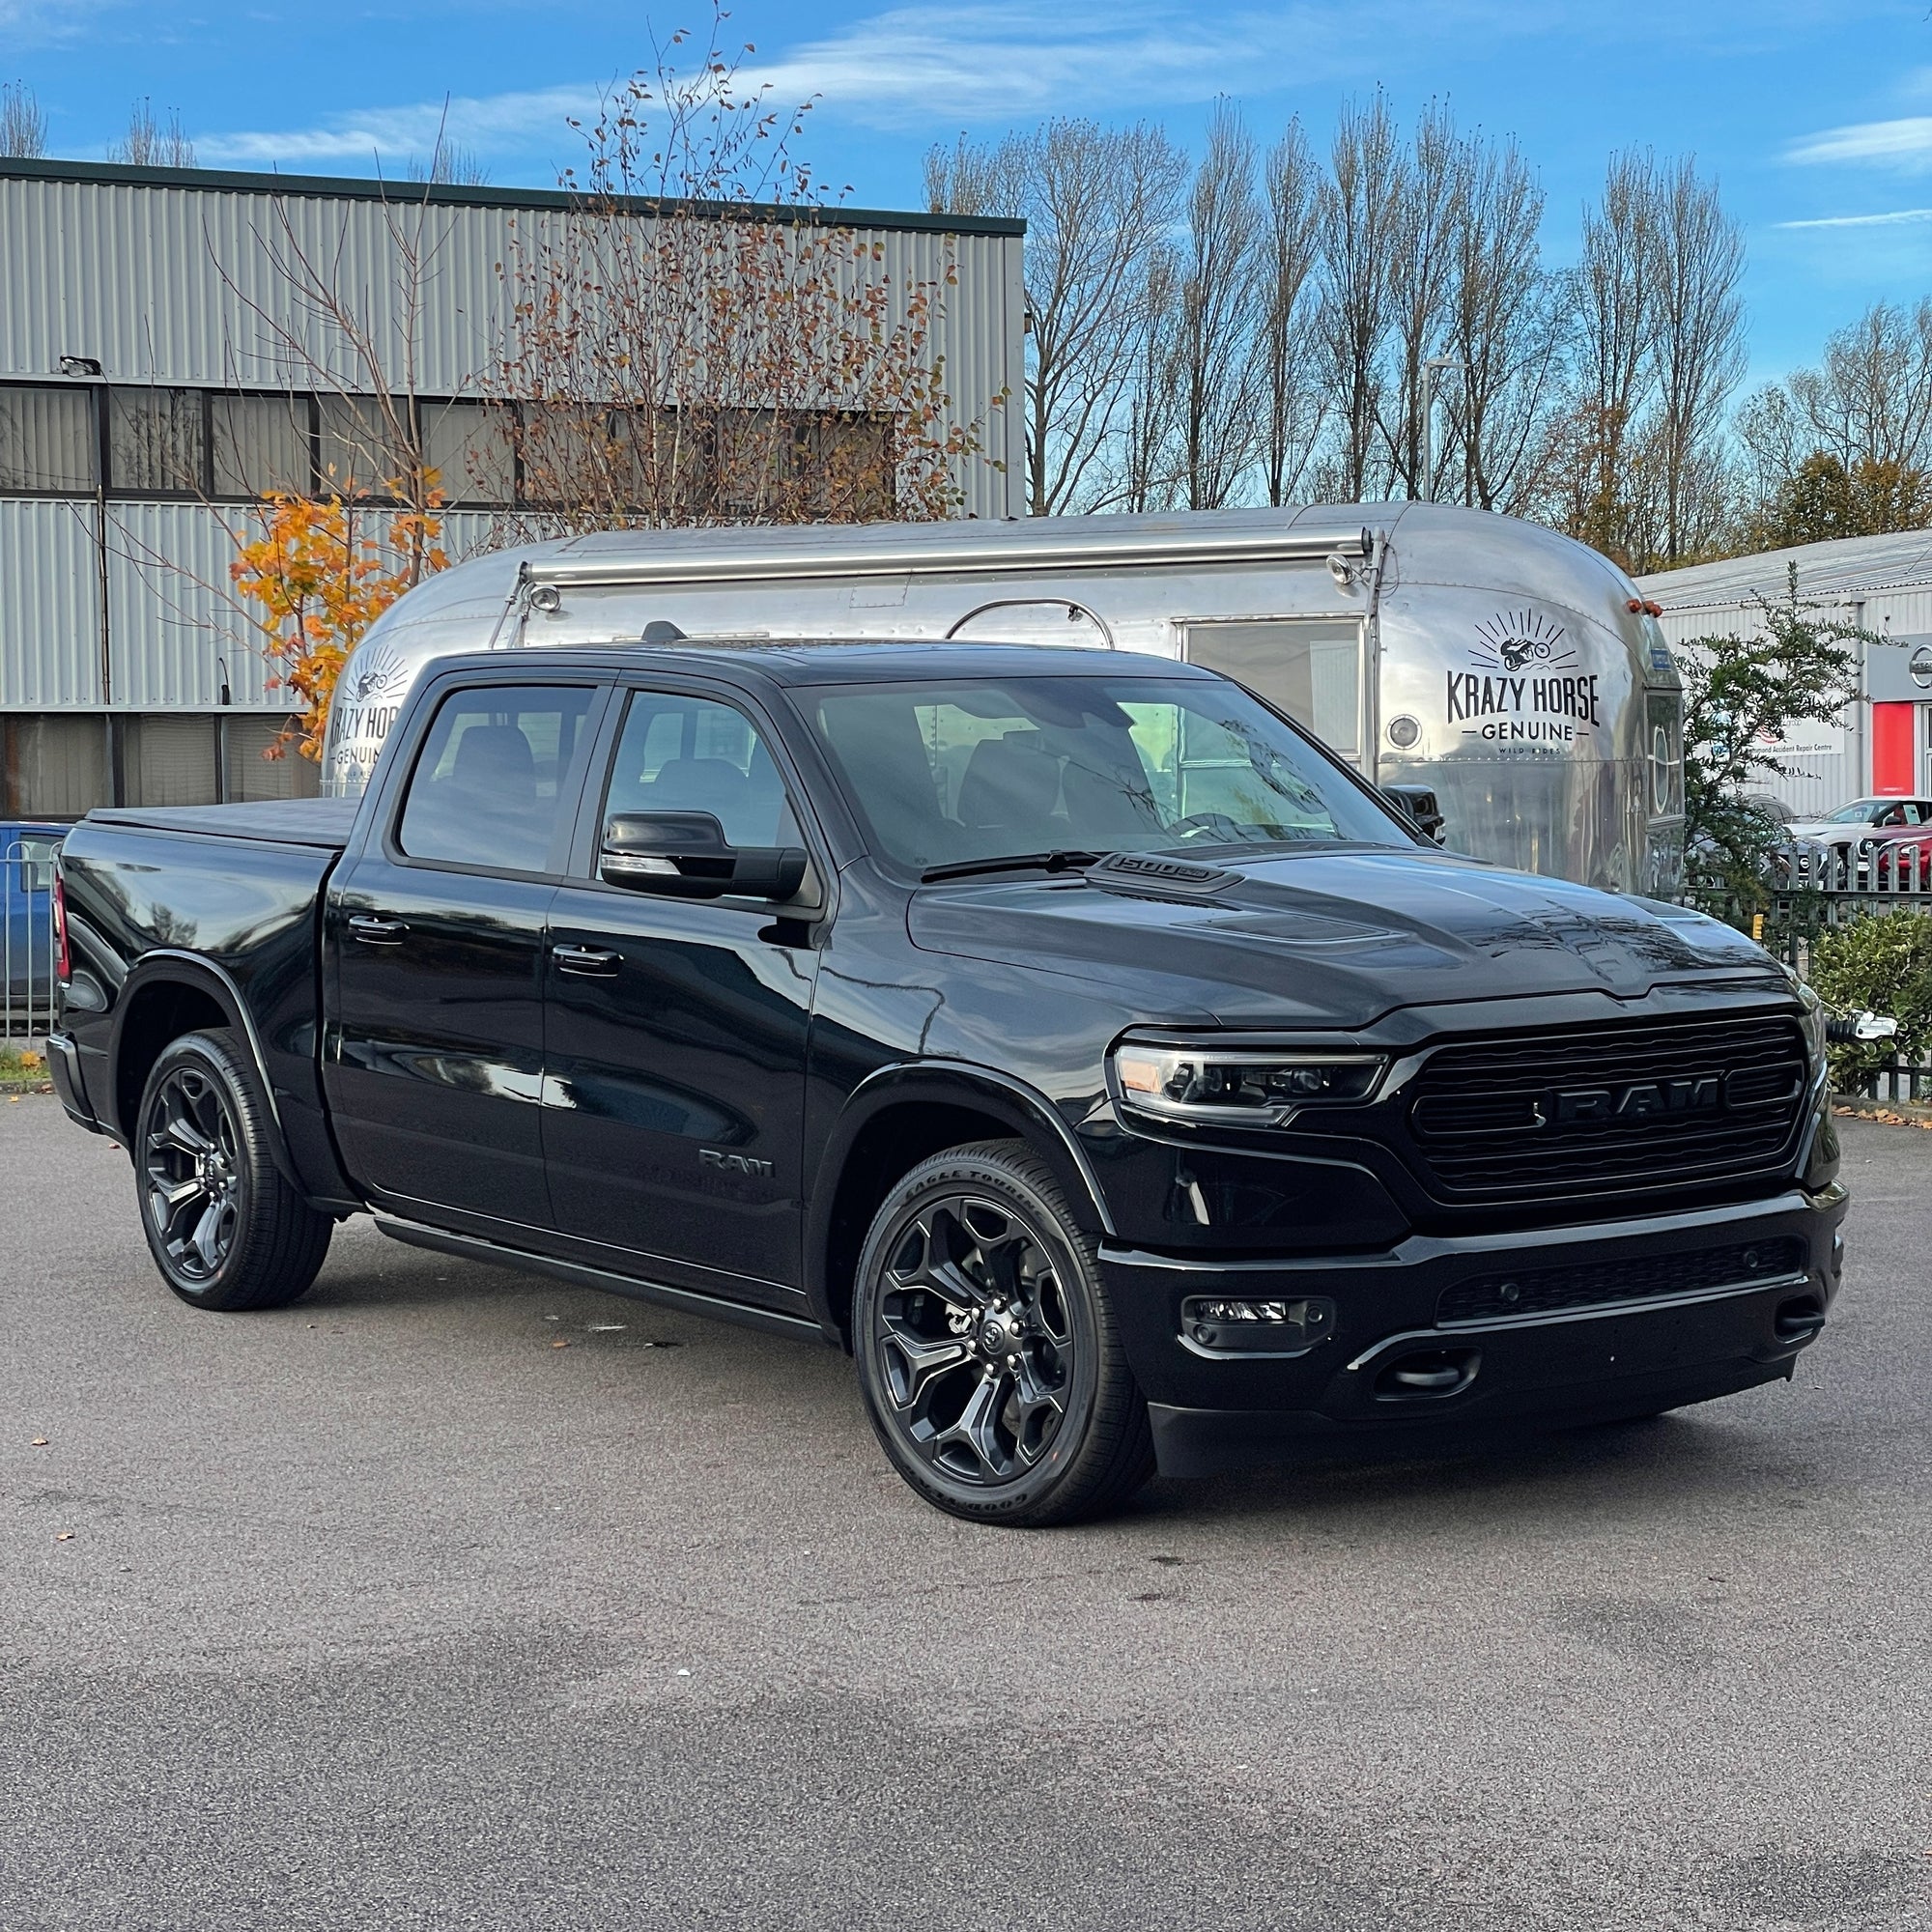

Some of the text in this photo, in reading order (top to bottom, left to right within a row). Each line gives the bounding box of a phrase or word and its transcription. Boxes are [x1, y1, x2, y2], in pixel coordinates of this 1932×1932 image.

[1447, 670, 1600, 726] KRAZY HORSE
[330, 705, 400, 750] KRAZY HOR
[1482, 722, 1573, 741] GENUINE
[337, 747, 380, 764] GENUIN
[1796, 744, 1812, 753] Repair
[1114, 856, 1176, 874] 1500
[1557, 1078, 1719, 1120] RAM
[699, 1149, 773, 1177] RAM
[905, 1170, 963, 1200] EAGLE
[969, 1170, 1046, 1221] TOURING
